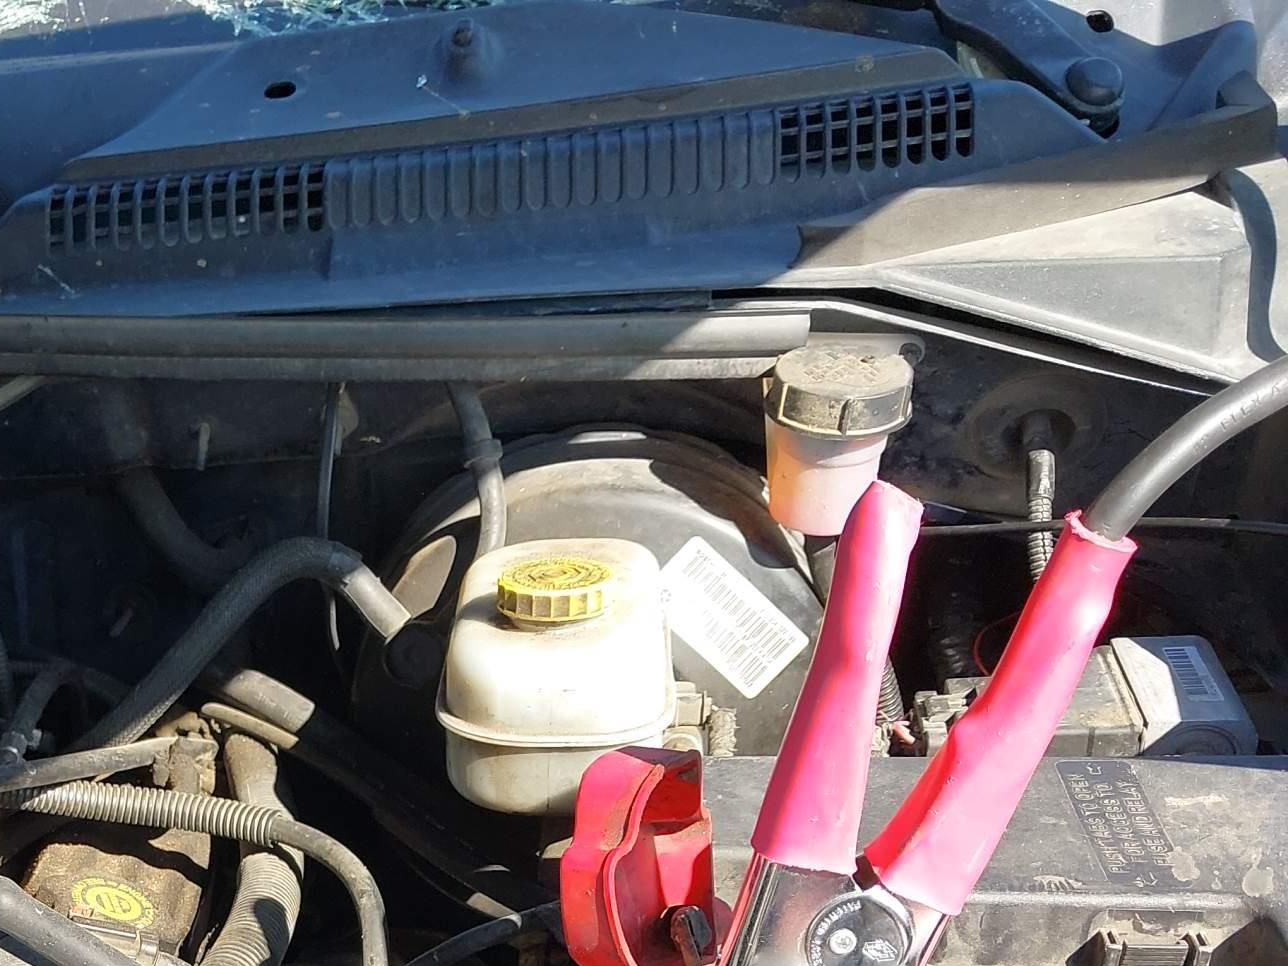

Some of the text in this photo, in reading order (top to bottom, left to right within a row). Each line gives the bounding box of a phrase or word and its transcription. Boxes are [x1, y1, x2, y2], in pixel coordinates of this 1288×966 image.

[1065, 774, 1095, 802] OPEN
[1093, 782, 1116, 798] TO
[1078, 802, 1102, 817] TO
